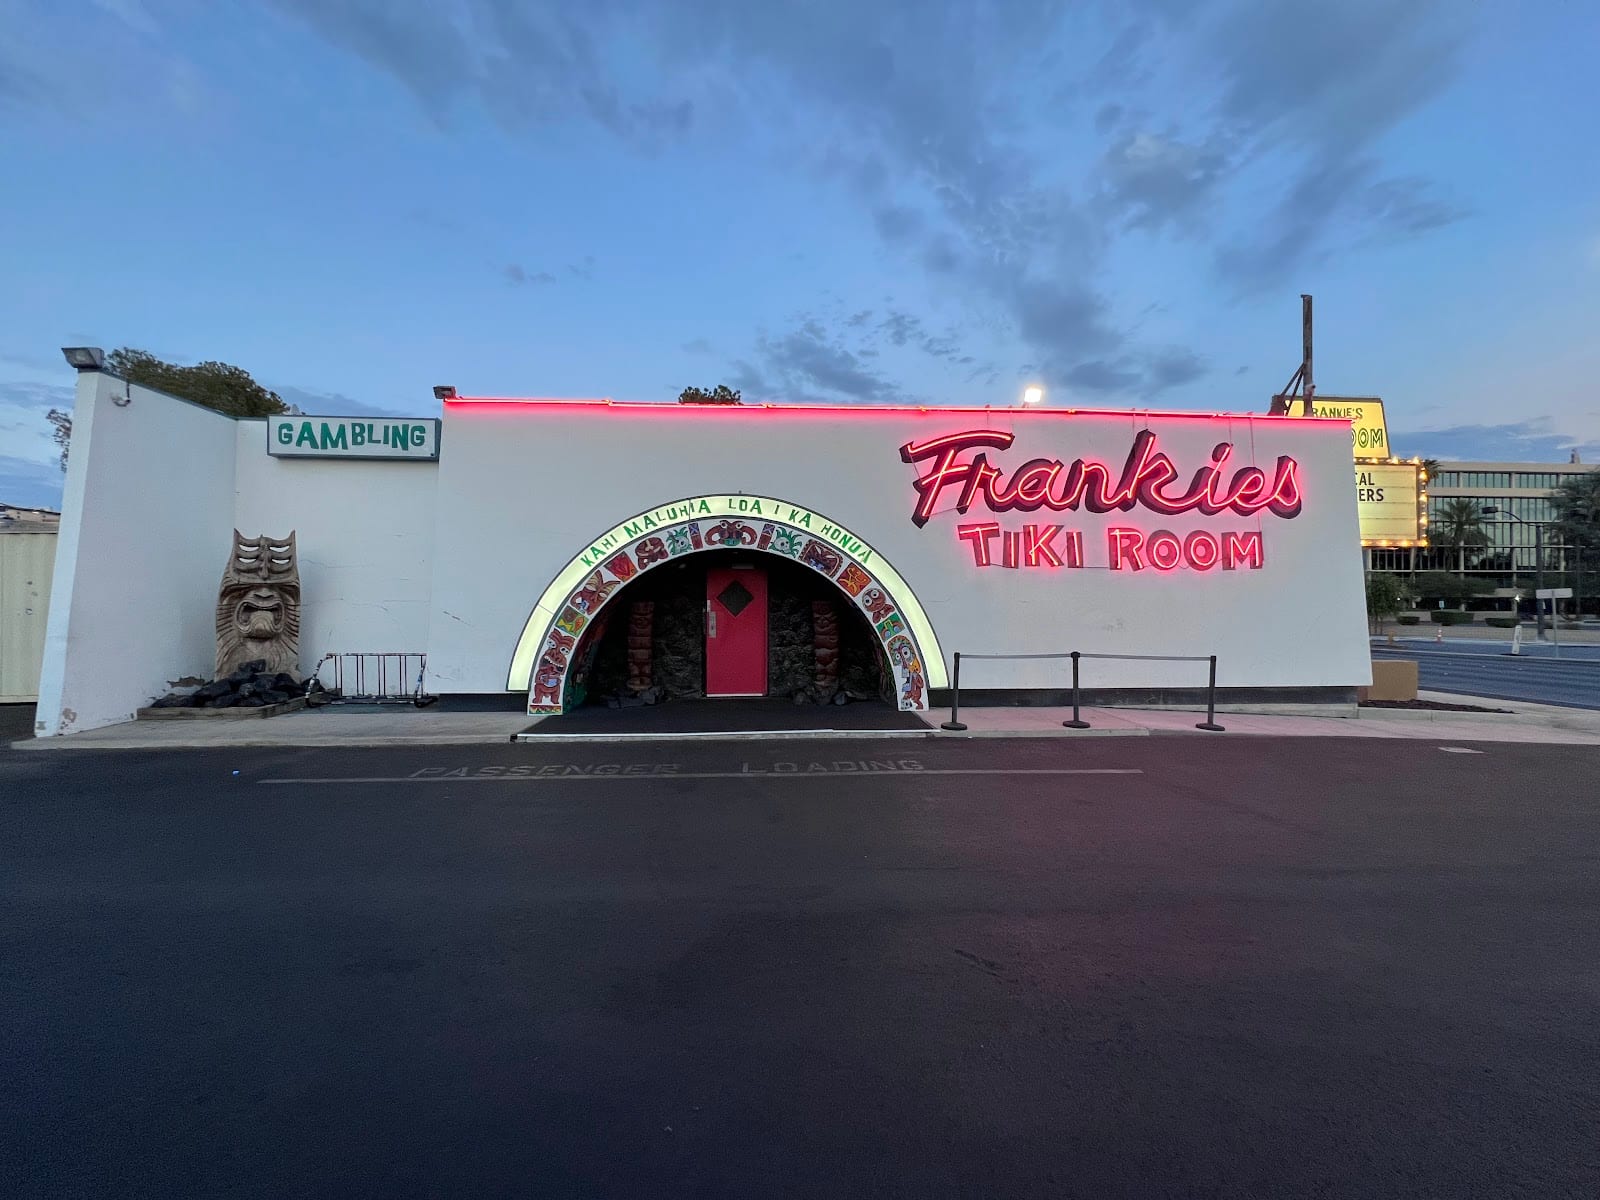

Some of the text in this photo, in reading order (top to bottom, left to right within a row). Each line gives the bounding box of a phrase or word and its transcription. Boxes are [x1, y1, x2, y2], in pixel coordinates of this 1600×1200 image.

[1312, 406, 1363, 419] RANKIE'S
[277, 421, 426, 451] GAMBLING
[899, 429, 1302, 528] Frankies
[1355, 471, 1375, 486] AL
[580, 498, 873, 567] KAHI MALUHIA LOA I KA HONUA
[958, 522, 1265, 572] TIKI ROOM
[408, 760, 924, 778] PASSENGER LOADING
